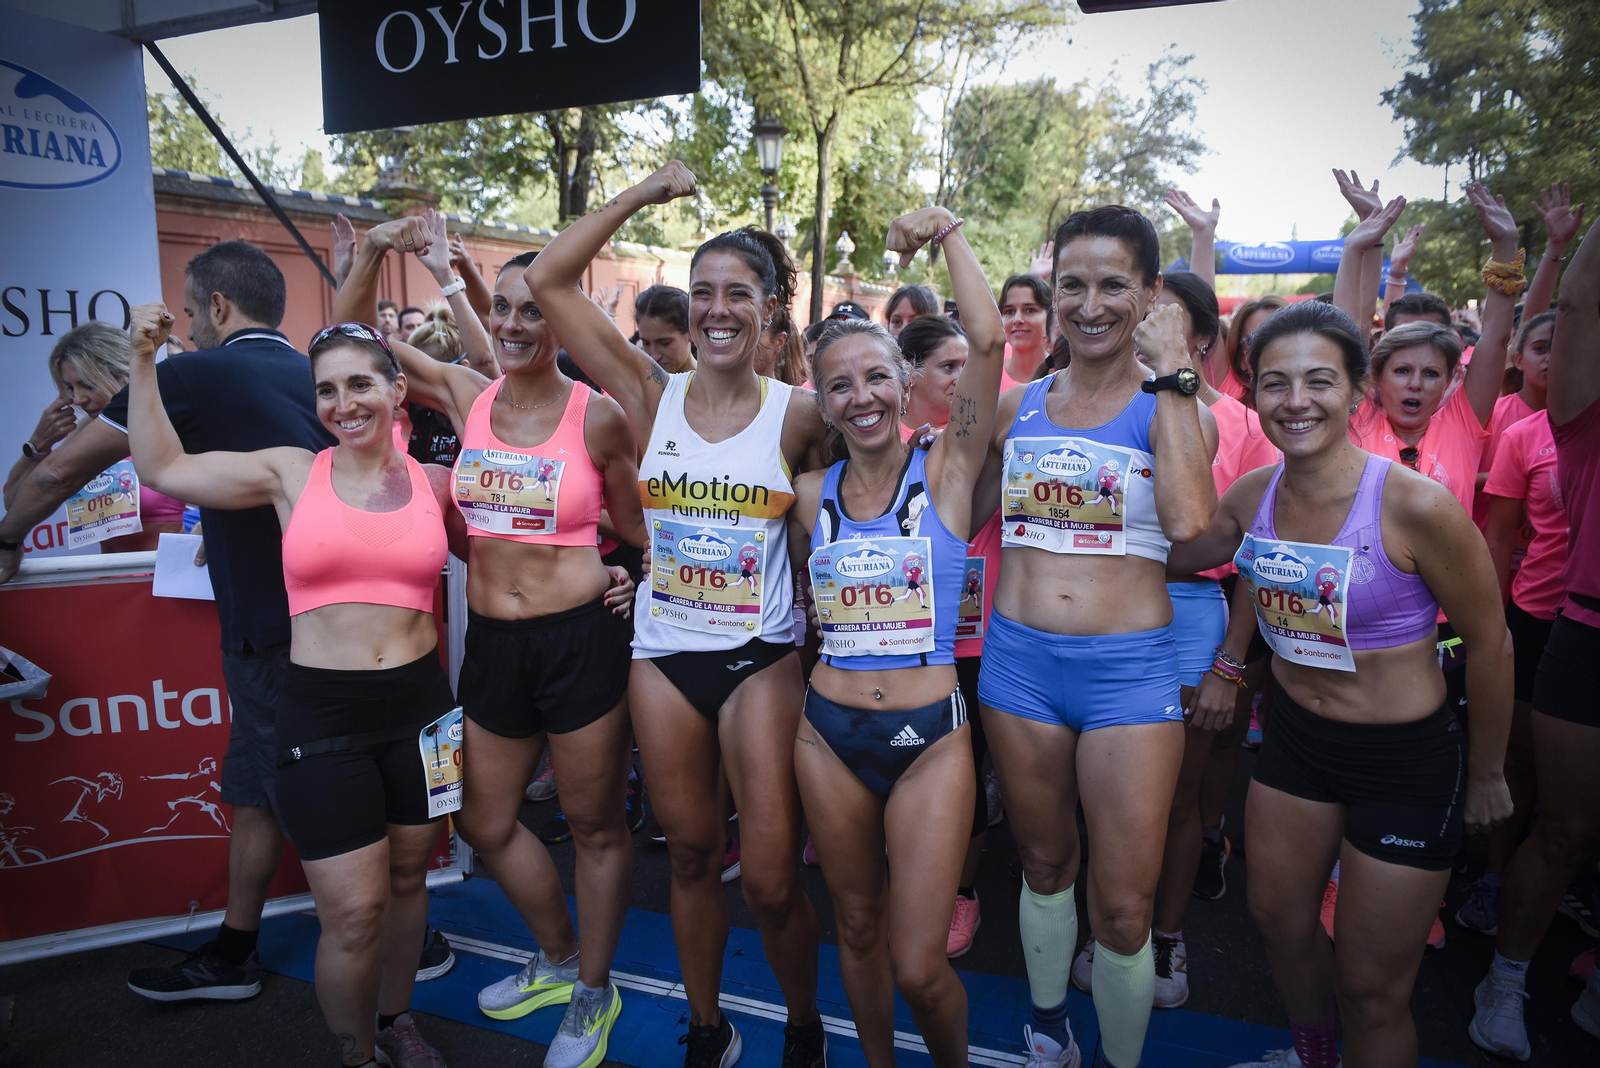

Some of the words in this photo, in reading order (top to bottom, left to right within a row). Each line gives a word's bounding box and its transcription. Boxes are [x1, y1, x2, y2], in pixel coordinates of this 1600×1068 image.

[376, 0, 636, 73] OYSHO
[24, 108, 97, 133] LECHERA
[1, 123, 107, 168] RIANA
[1234, 247, 1290, 260] ASTURIANA
[2, 286, 131, 337] SHO
[484, 450, 529, 462] ASTURIANA
[1039, 458, 1087, 471] ASTURIANA
[480, 470, 524, 491] 016
[647, 470, 769, 506] eMotion
[1033, 482, 1082, 506] 016
[88, 493, 113, 512] 016
[490, 493, 506, 503] 781
[509, 506, 531, 514] MUJER
[671, 503, 740, 526] running
[1048, 507, 1070, 519] 1854
[110, 523, 133, 532] Santander
[1027, 516, 1053, 526] CARRERA
[1054, 520, 1060, 528] DE
[1061, 521, 1069, 529] LA
[1071, 522, 1095, 530] MUJER
[74, 532, 95, 543] OYSHO
[658, 532, 675, 542] SUMA
[681, 541, 728, 557] ASTURIANA
[840, 561, 891, 572] ASTURIANA
[1255, 561, 1304, 579] ASTURIANA
[680, 565, 725, 588] 016
[697, 591, 704, 601] 2
[841, 584, 893, 606] 016
[1257, 587, 1303, 615] 016
[669, 596, 694, 607] CARRERA
[714, 604, 736, 612] MUJER
[659, 606, 688, 620] OYSHO
[864, 611, 870, 621] 1
[717, 619, 747, 628] Santand
[833, 624, 861, 632] CARRERA
[862, 623, 871, 631] DE
[872, 622, 881, 630] LA
[883, 621, 907, 629] MUJER
[1276, 616, 1289, 628] 14
[888, 637, 925, 646] Santander
[1287, 630, 1296, 638] LA
[1297, 632, 1322, 641] MUJER
[1303, 648, 1342, 660] Santander
[10, 679, 233, 742] Santa
[890, 737, 926, 746] adidas
[1391, 837, 1426, 848] asics
